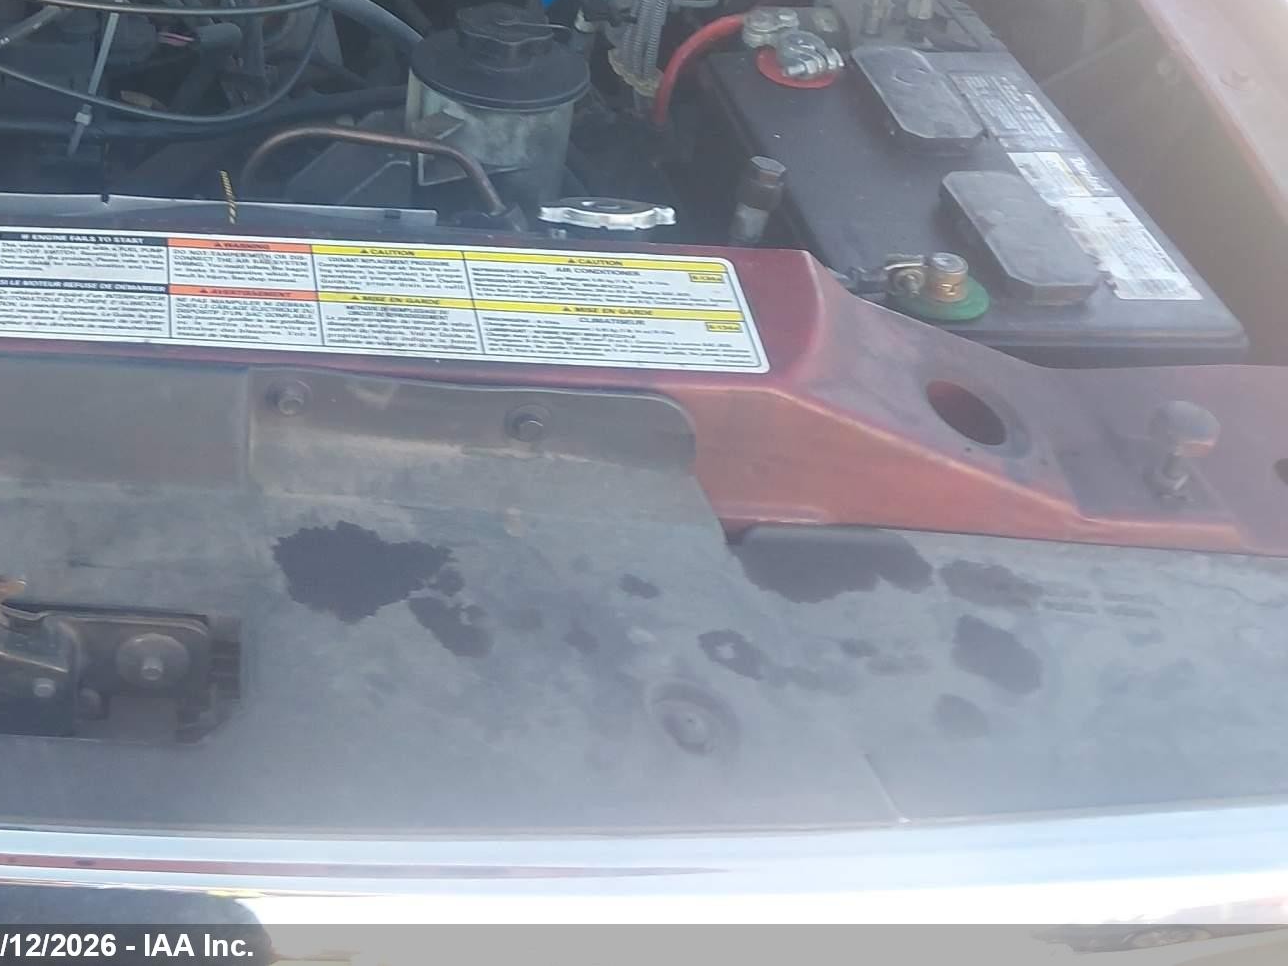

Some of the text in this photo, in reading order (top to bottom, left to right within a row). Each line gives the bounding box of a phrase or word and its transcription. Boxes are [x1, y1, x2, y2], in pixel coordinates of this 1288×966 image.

[114, 236, 144, 244] START
[370, 249, 415, 257] CAUTION
[578, 258, 623, 266] CAUTION
[574, 268, 641, 277] CONDITIONER
